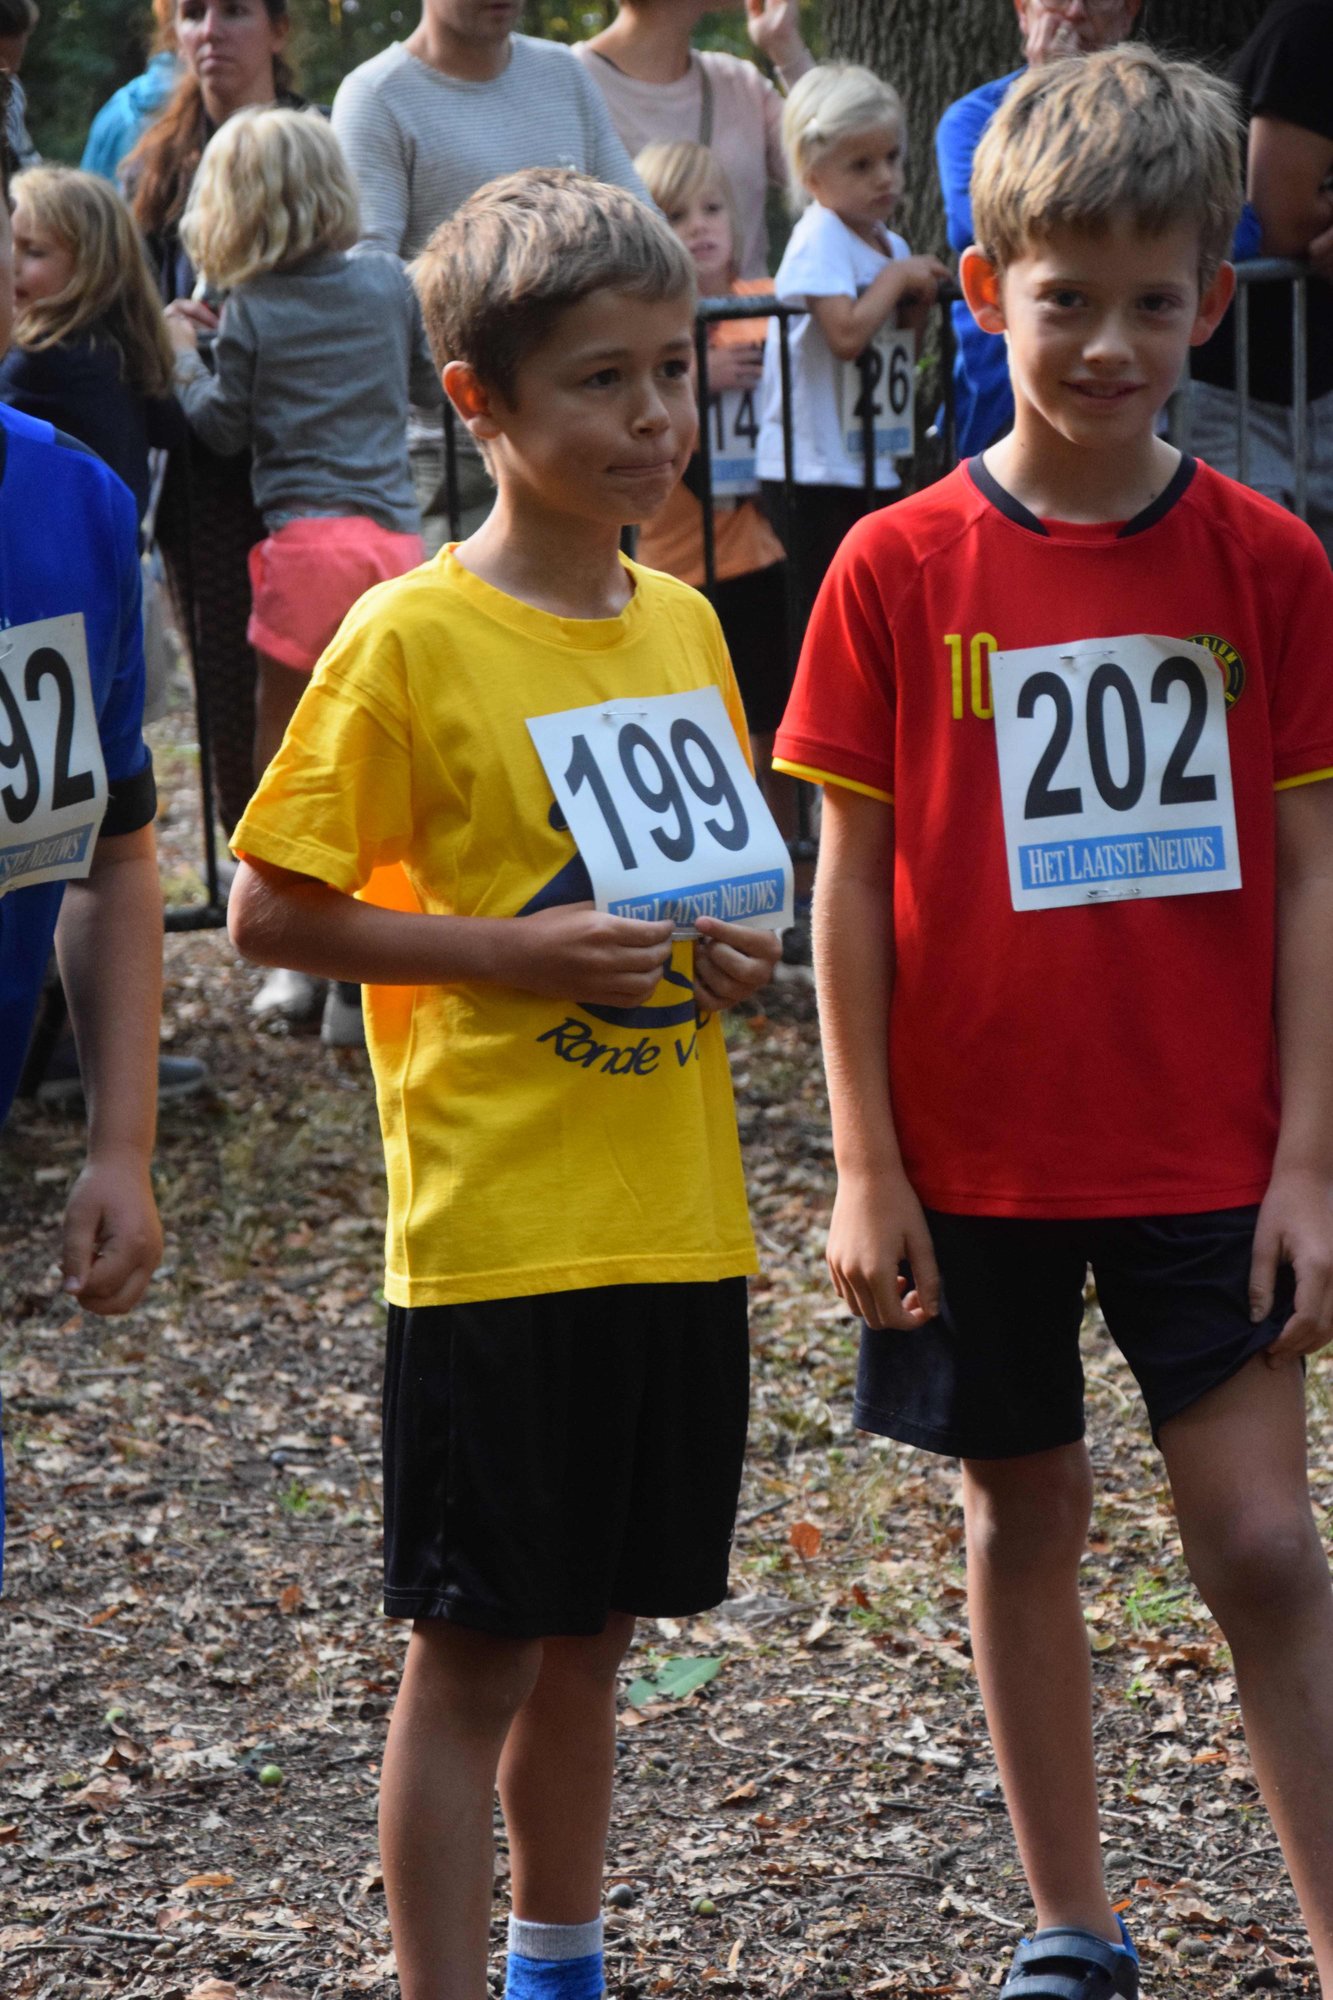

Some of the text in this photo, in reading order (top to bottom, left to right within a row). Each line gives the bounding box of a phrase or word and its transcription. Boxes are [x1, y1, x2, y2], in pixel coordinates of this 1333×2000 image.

[855, 346, 909, 416] 26
[944, 632, 998, 720] 10
[1017, 656, 1217, 820] 202
[564, 718, 750, 871] 199
[1028, 836, 1217, 885] HET LAATSTE NIEUWS
[720, 879, 778, 919] NIEUWS
[536, 1017, 662, 1075] Ronde
